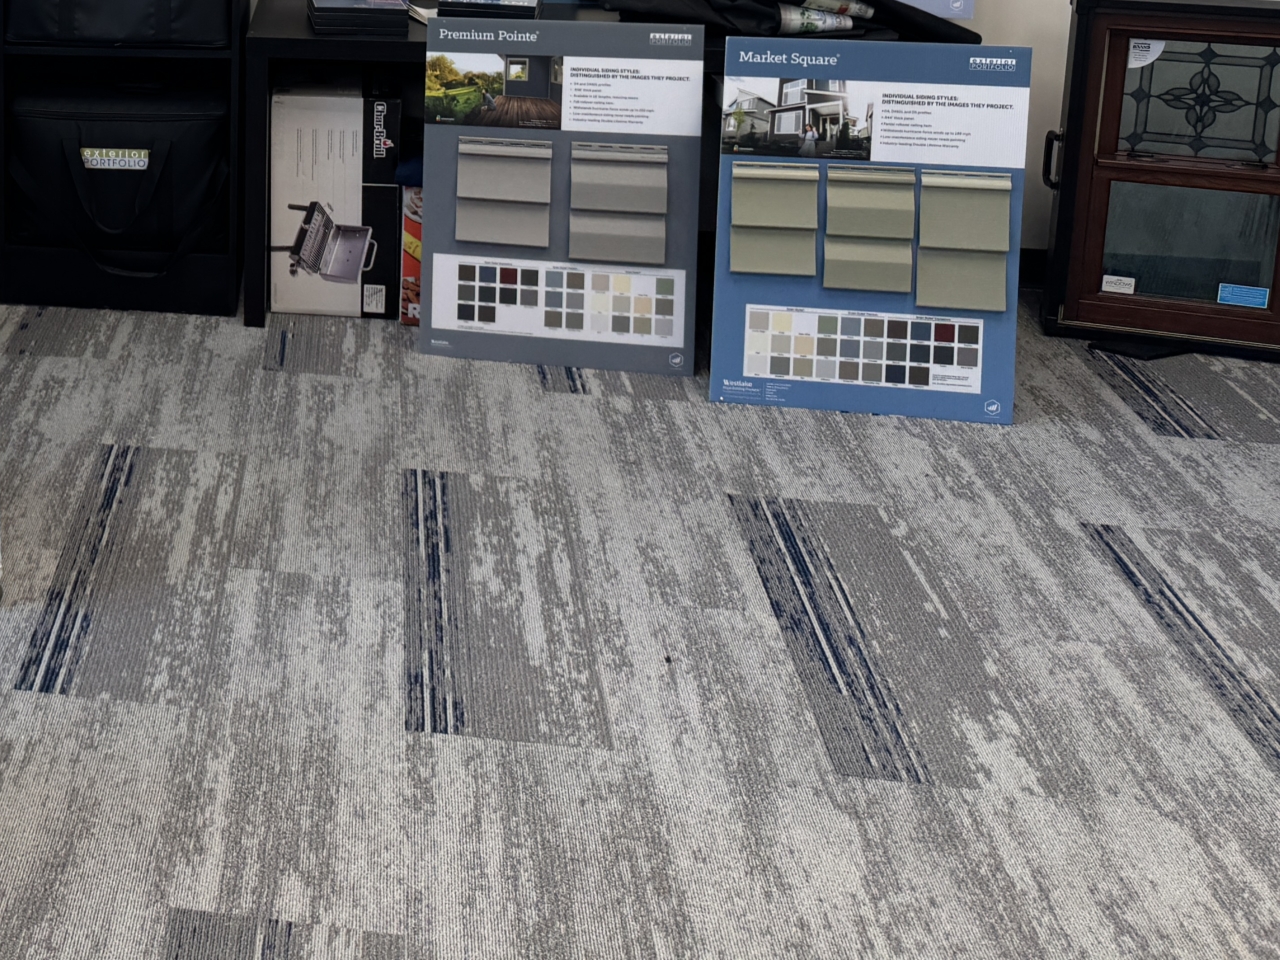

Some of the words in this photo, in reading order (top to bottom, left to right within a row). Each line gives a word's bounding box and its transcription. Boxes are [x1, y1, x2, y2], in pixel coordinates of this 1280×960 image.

[439, 29, 495, 41] Premium
[498, 31, 538, 41] Pointe
[739, 51, 787, 64] Market
[791, 53, 837, 66] Square
[374, 102, 386, 158] Char-Broil
[83, 149, 146, 159] exterior
[83, 158, 146, 168] PORTFOLIO
[723, 379, 752, 387] Westlake
